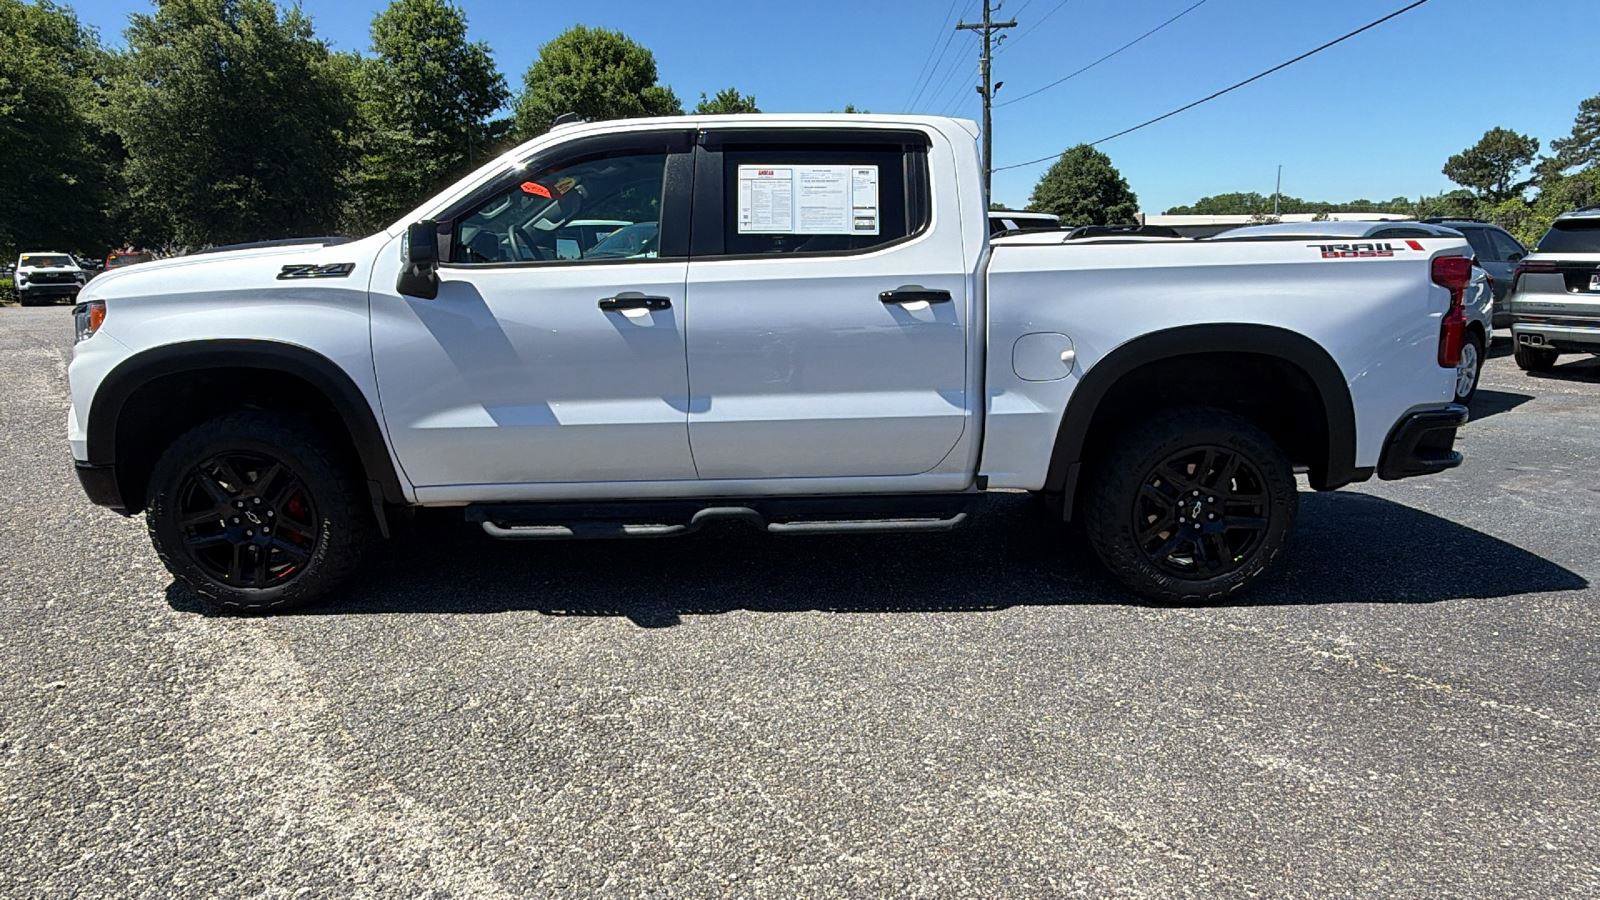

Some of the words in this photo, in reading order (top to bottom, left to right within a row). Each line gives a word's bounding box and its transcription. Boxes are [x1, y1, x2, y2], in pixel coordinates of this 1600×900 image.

[1307, 243, 1405, 252] TRAIL
[1322, 251, 1394, 259] BOSS
[276, 263, 356, 280] Z71
